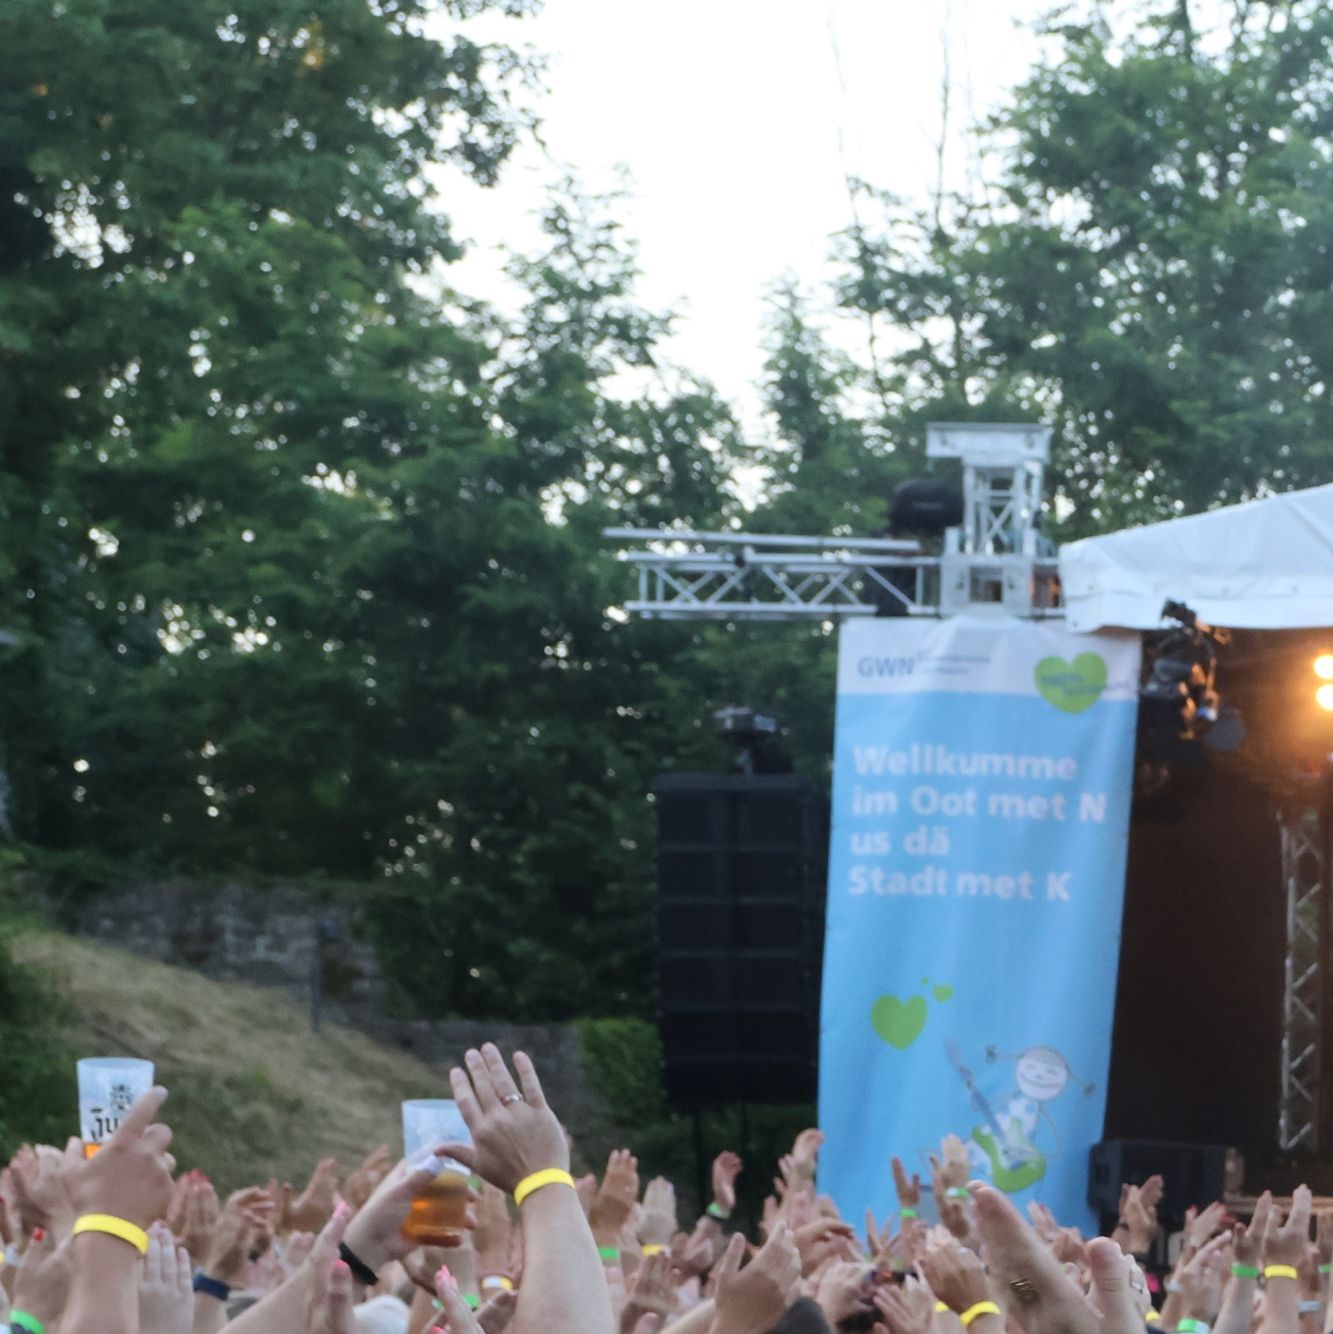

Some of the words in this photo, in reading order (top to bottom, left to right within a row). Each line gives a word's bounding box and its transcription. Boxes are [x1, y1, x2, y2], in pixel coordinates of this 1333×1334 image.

[857, 656, 914, 677] GWN
[856, 746, 1077, 779] Wellkumme
[855, 786, 895, 815] im
[913, 787, 977, 816] Oot
[990, 792, 1066, 819] met
[1081, 795, 1105, 821] N
[854, 833, 890, 854] us
[906, 826, 949, 855] dä
[851, 867, 947, 895] Stadt
[959, 871, 1033, 898] met
[1049, 873, 1071, 900] K
